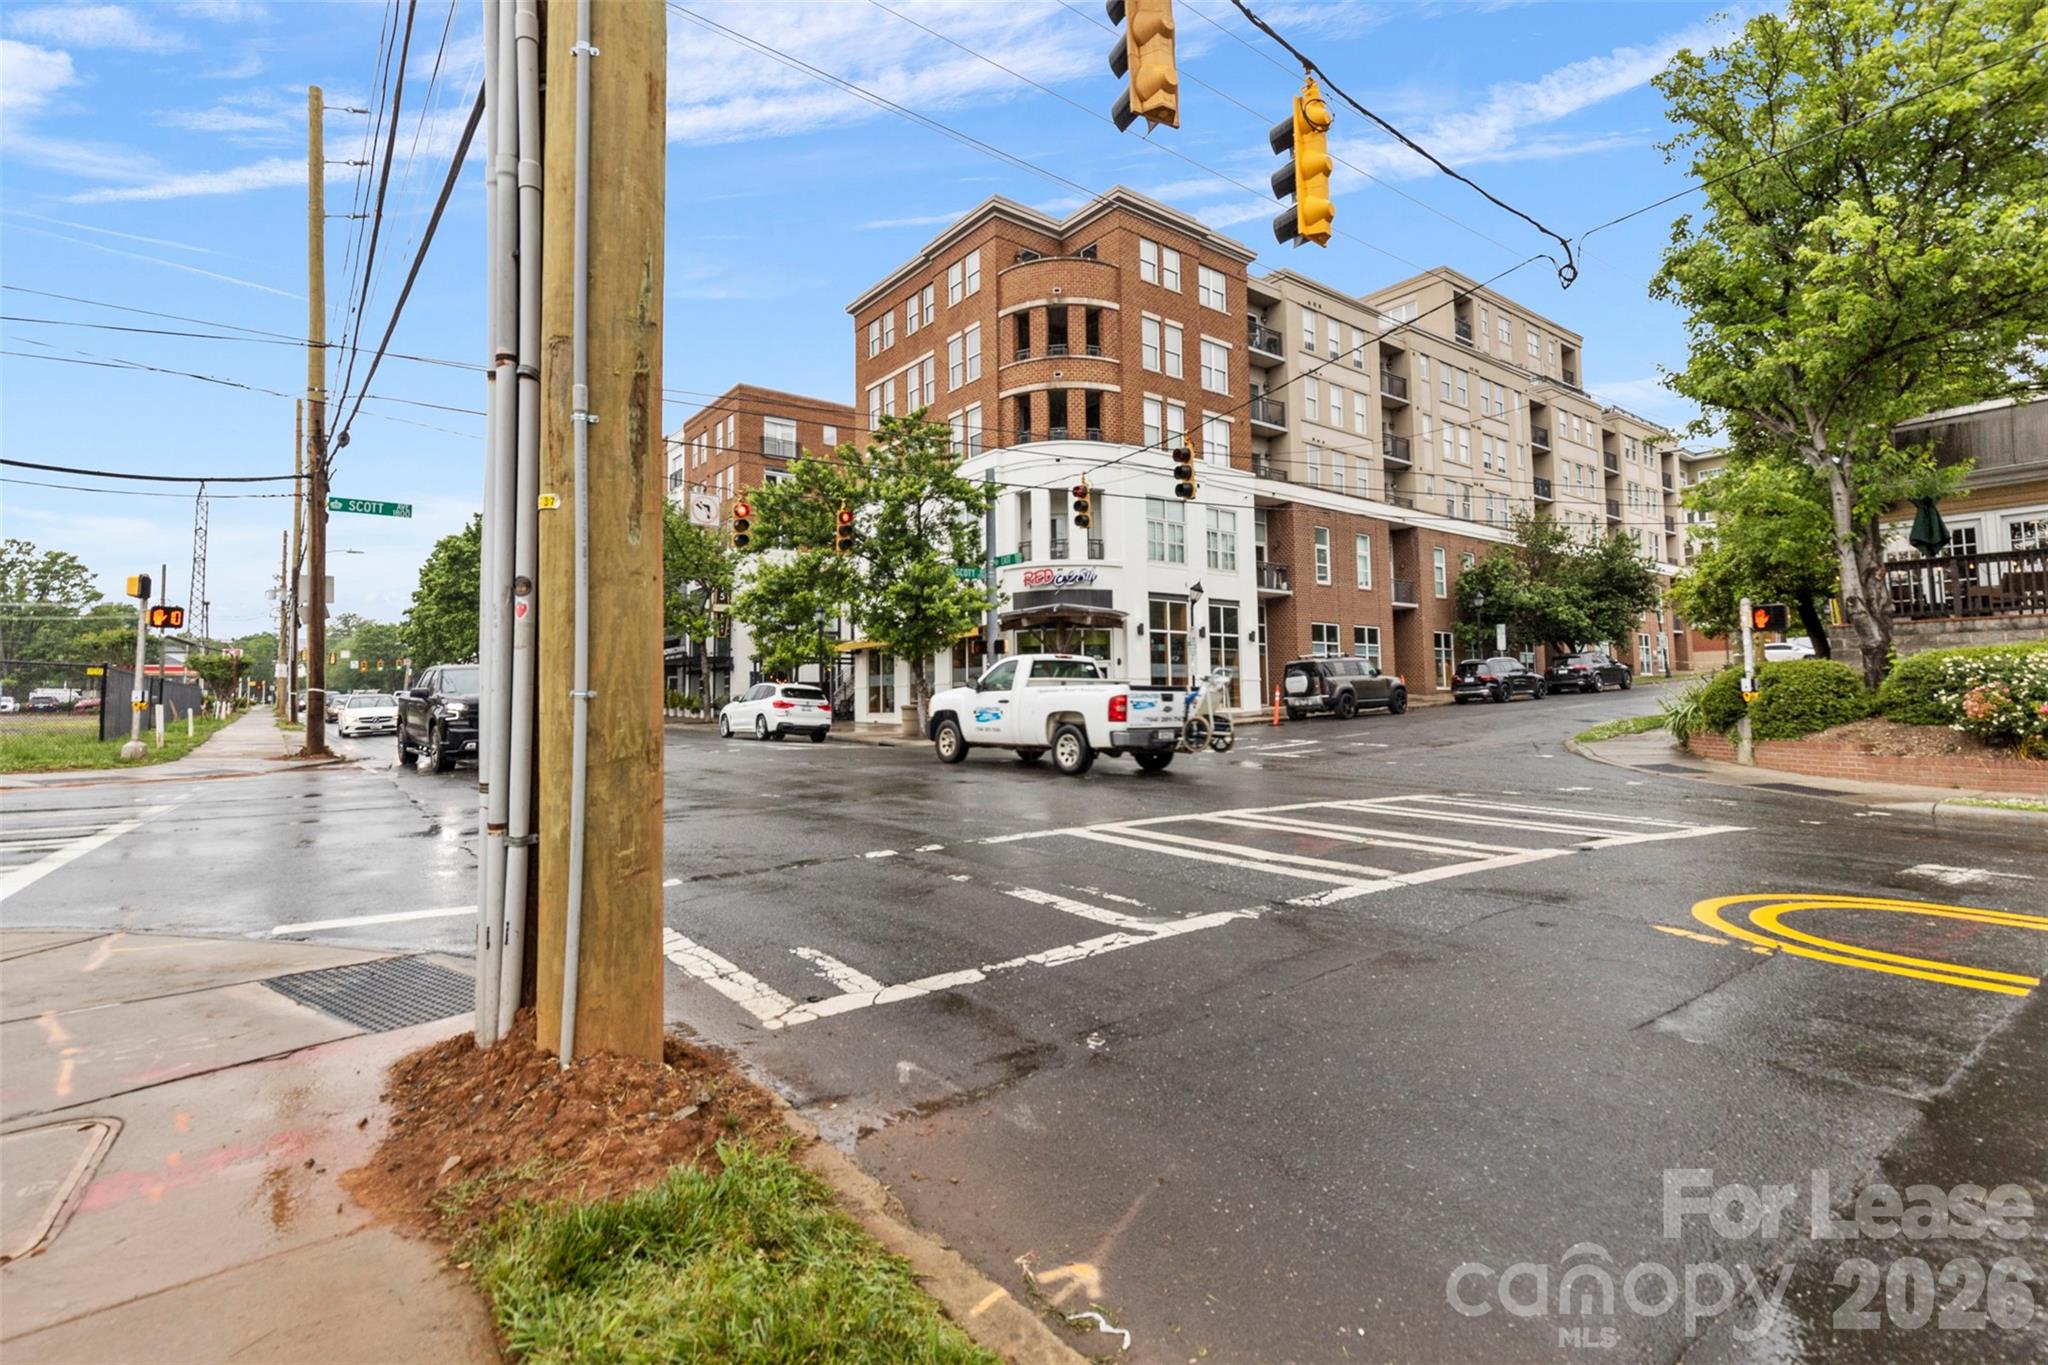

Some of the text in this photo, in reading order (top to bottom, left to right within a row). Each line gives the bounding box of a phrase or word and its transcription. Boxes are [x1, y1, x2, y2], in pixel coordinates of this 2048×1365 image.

[348, 500, 384, 513] SCOTT
[955, 567, 975, 578] SCOTT
[1024, 568, 1054, 586] RED
